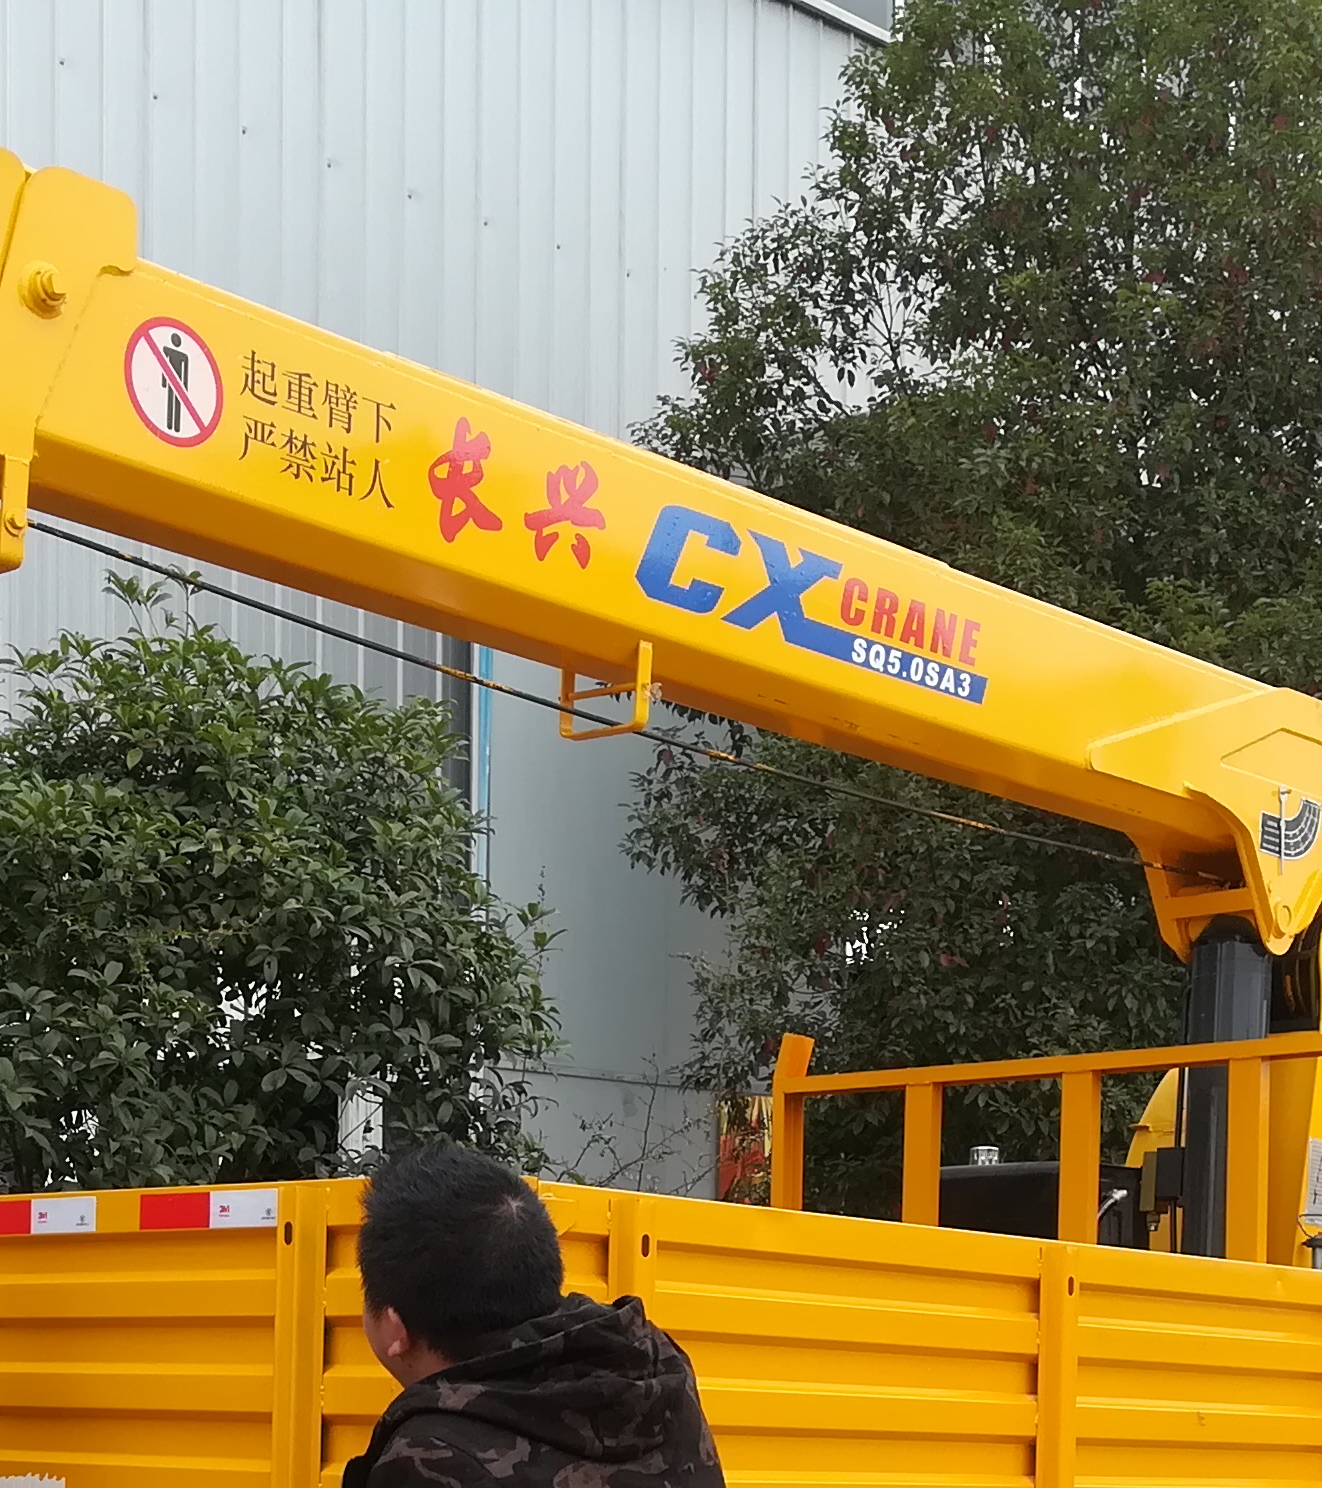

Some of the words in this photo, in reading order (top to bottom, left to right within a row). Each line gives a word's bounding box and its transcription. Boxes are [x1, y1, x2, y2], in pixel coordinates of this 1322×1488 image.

[239, 350, 397, 444] 起重臂下
[238, 414, 395, 510] 严禁站人
[427, 416, 607, 570] 长兴
[634, 504, 844, 644] CX
[840, 577, 982, 667] CRANE
[851, 638, 973, 698] SQ5.0SA3
